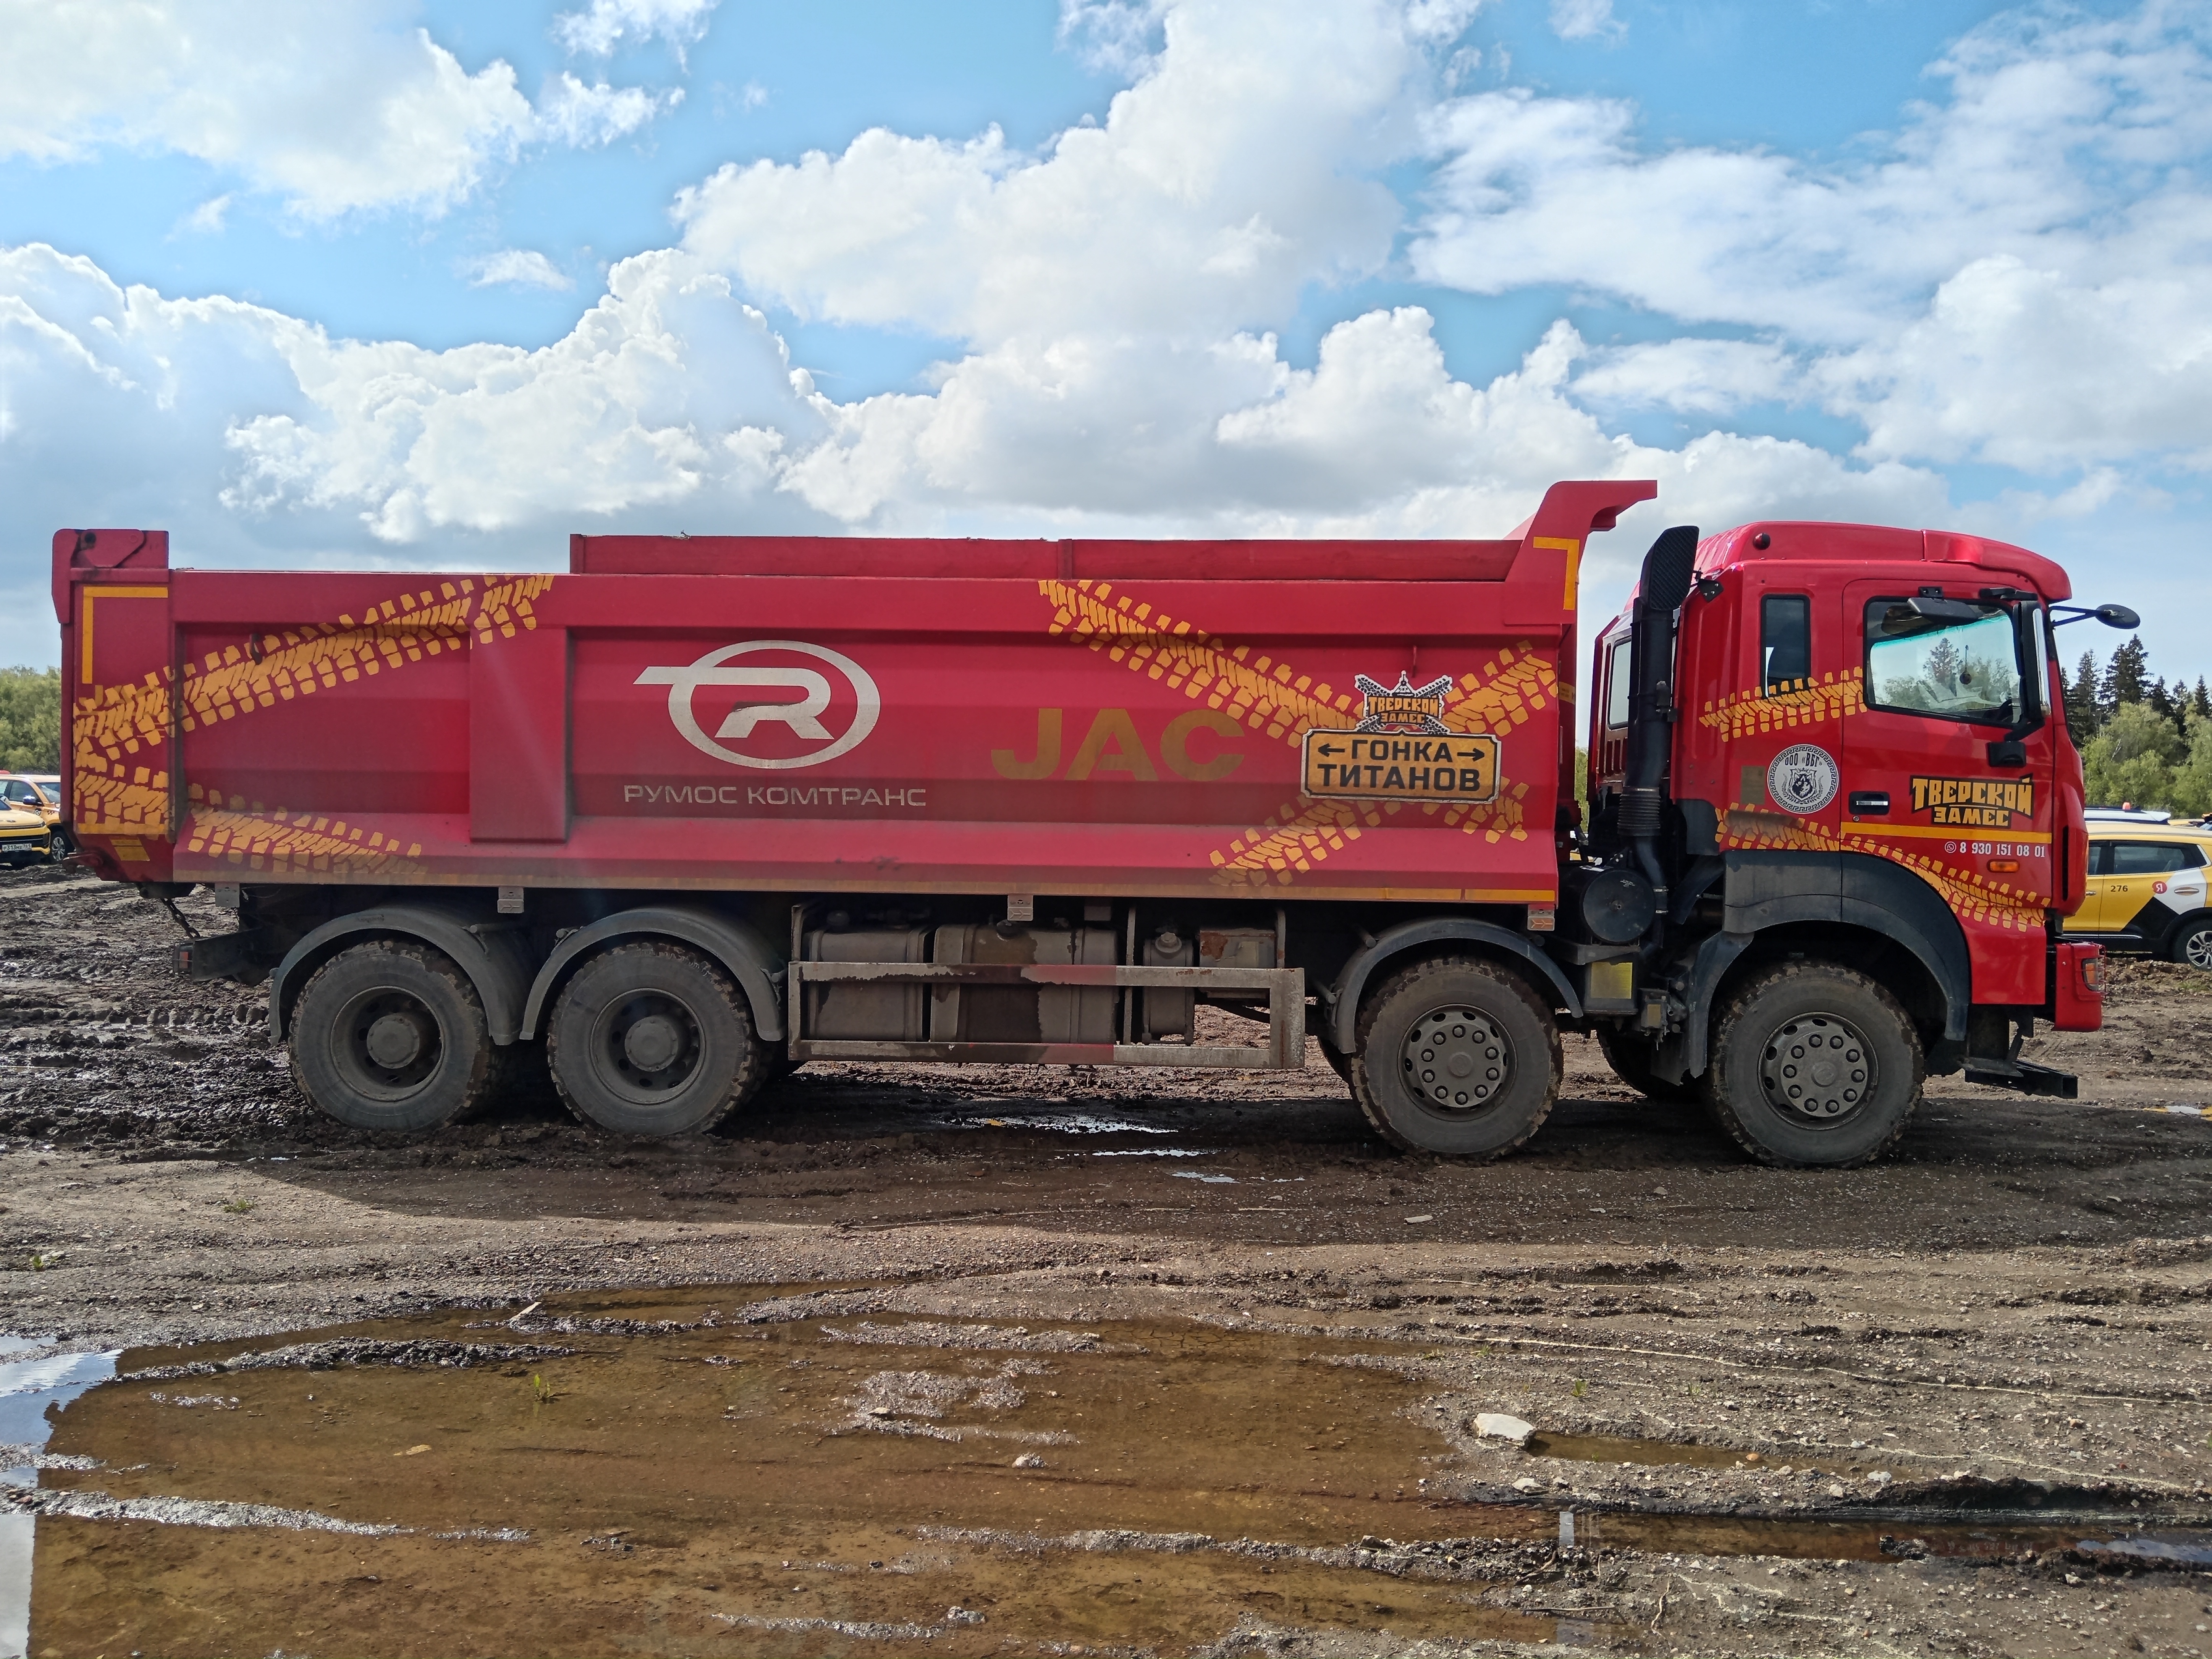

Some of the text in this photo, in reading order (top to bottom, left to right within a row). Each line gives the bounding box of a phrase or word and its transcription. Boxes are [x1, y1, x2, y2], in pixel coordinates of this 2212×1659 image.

[1368, 695, 1439, 716] ТВЕРСКОЙ
[1380, 713, 1425, 723] ЗАМЕС
[991, 708, 1245, 781] JAC
[1351, 739, 1453, 763] ГОНКА
[1785, 753, 1798, 766] ООО
[1317, 764, 1480, 792] ТИТАНОВ
[624, 785, 927, 807] РУМОС КОМТРАНС
[1912, 777, 2032, 816] ТВЕРСКОЙ
[1934, 807, 2009, 826] ЗАМЕС
[1960, 842, 2045, 857] 8 930 151 08 01
[2155, 883, 2163, 892] Я
